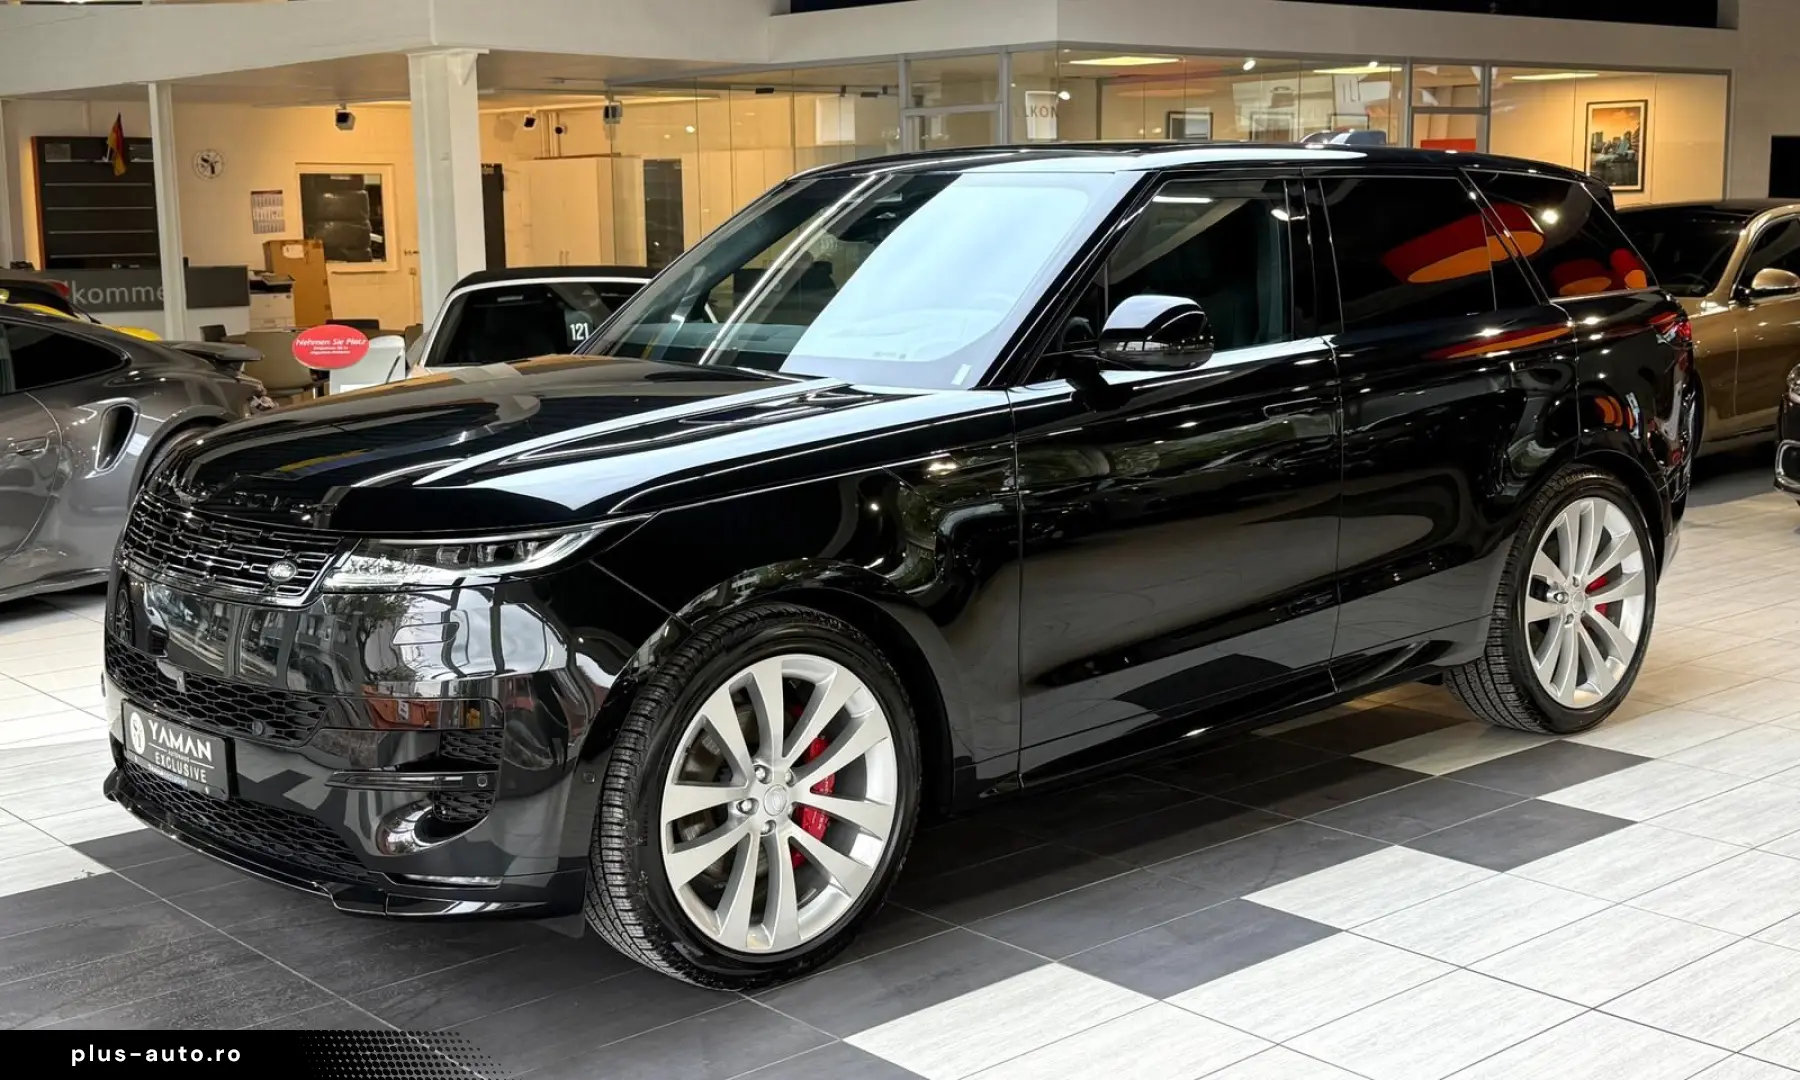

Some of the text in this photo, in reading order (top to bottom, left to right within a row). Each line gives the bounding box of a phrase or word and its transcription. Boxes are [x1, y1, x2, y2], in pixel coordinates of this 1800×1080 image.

[332, 338, 344, 346] Sie
[346, 337, 367, 345] Platz
[570, 322, 589, 341] 121
[148, 719, 213, 762] YAMAN
[155, 751, 208, 784] EXCLUSIVE
